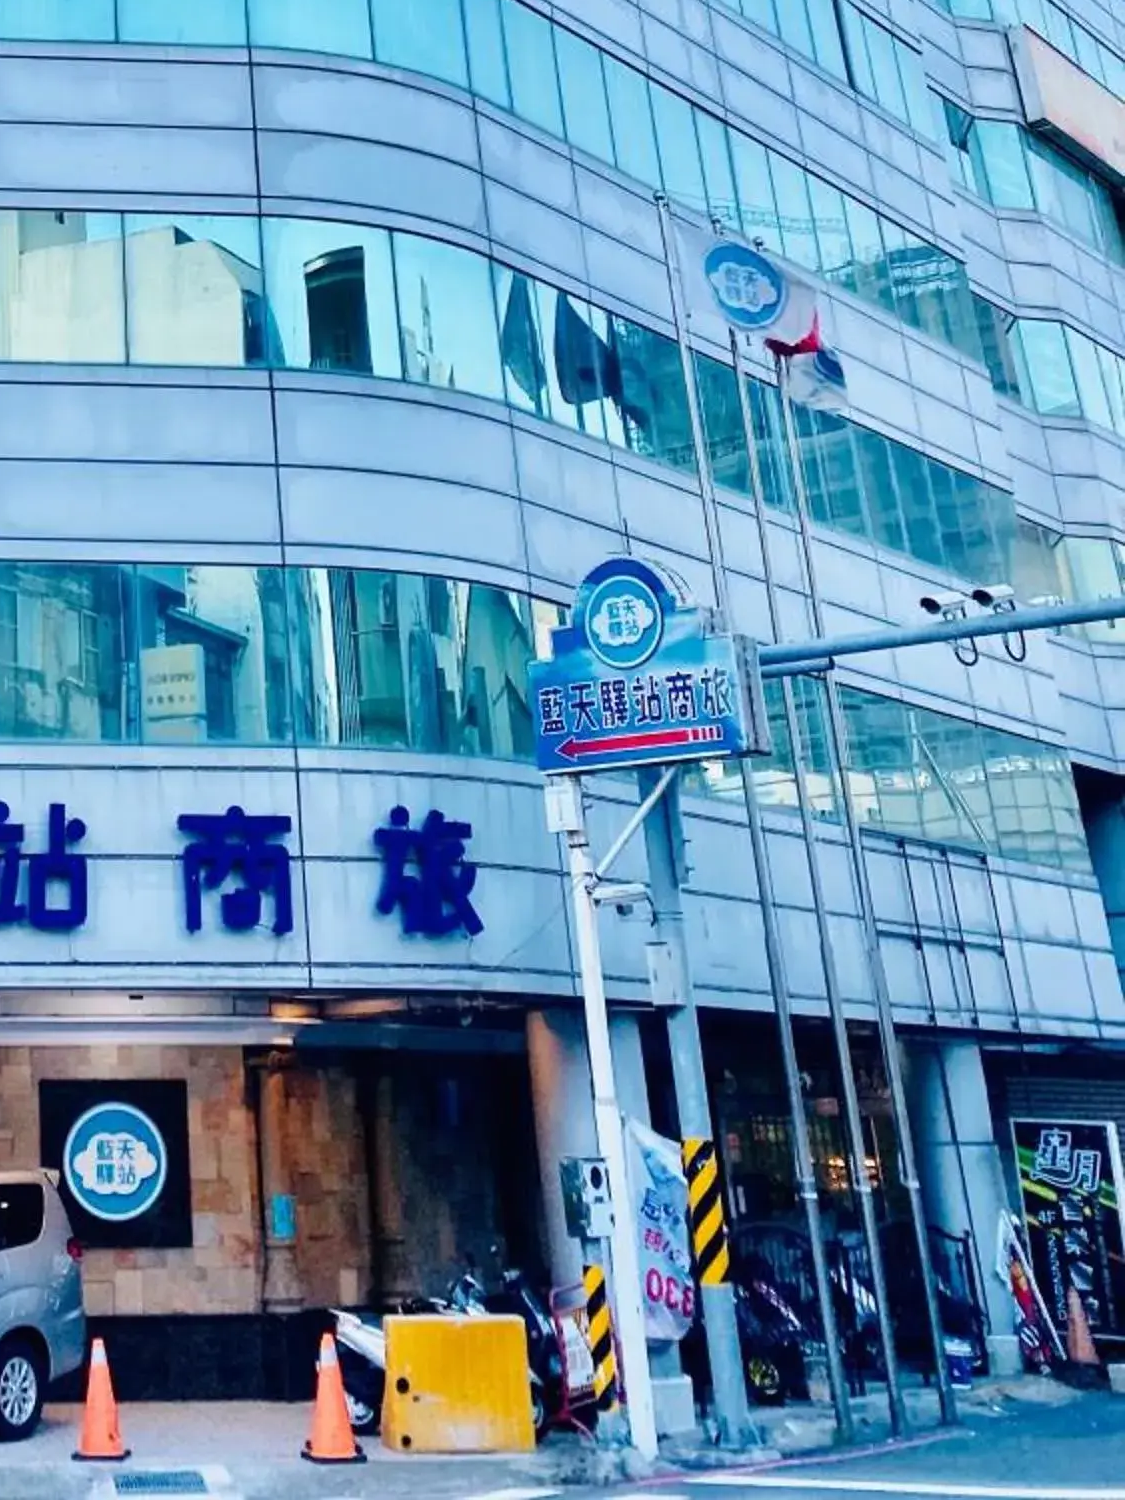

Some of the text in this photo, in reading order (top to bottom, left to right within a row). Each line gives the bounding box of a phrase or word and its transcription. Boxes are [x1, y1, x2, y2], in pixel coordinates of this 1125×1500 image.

[539, 667, 733, 734] 藍天驛站商旅
